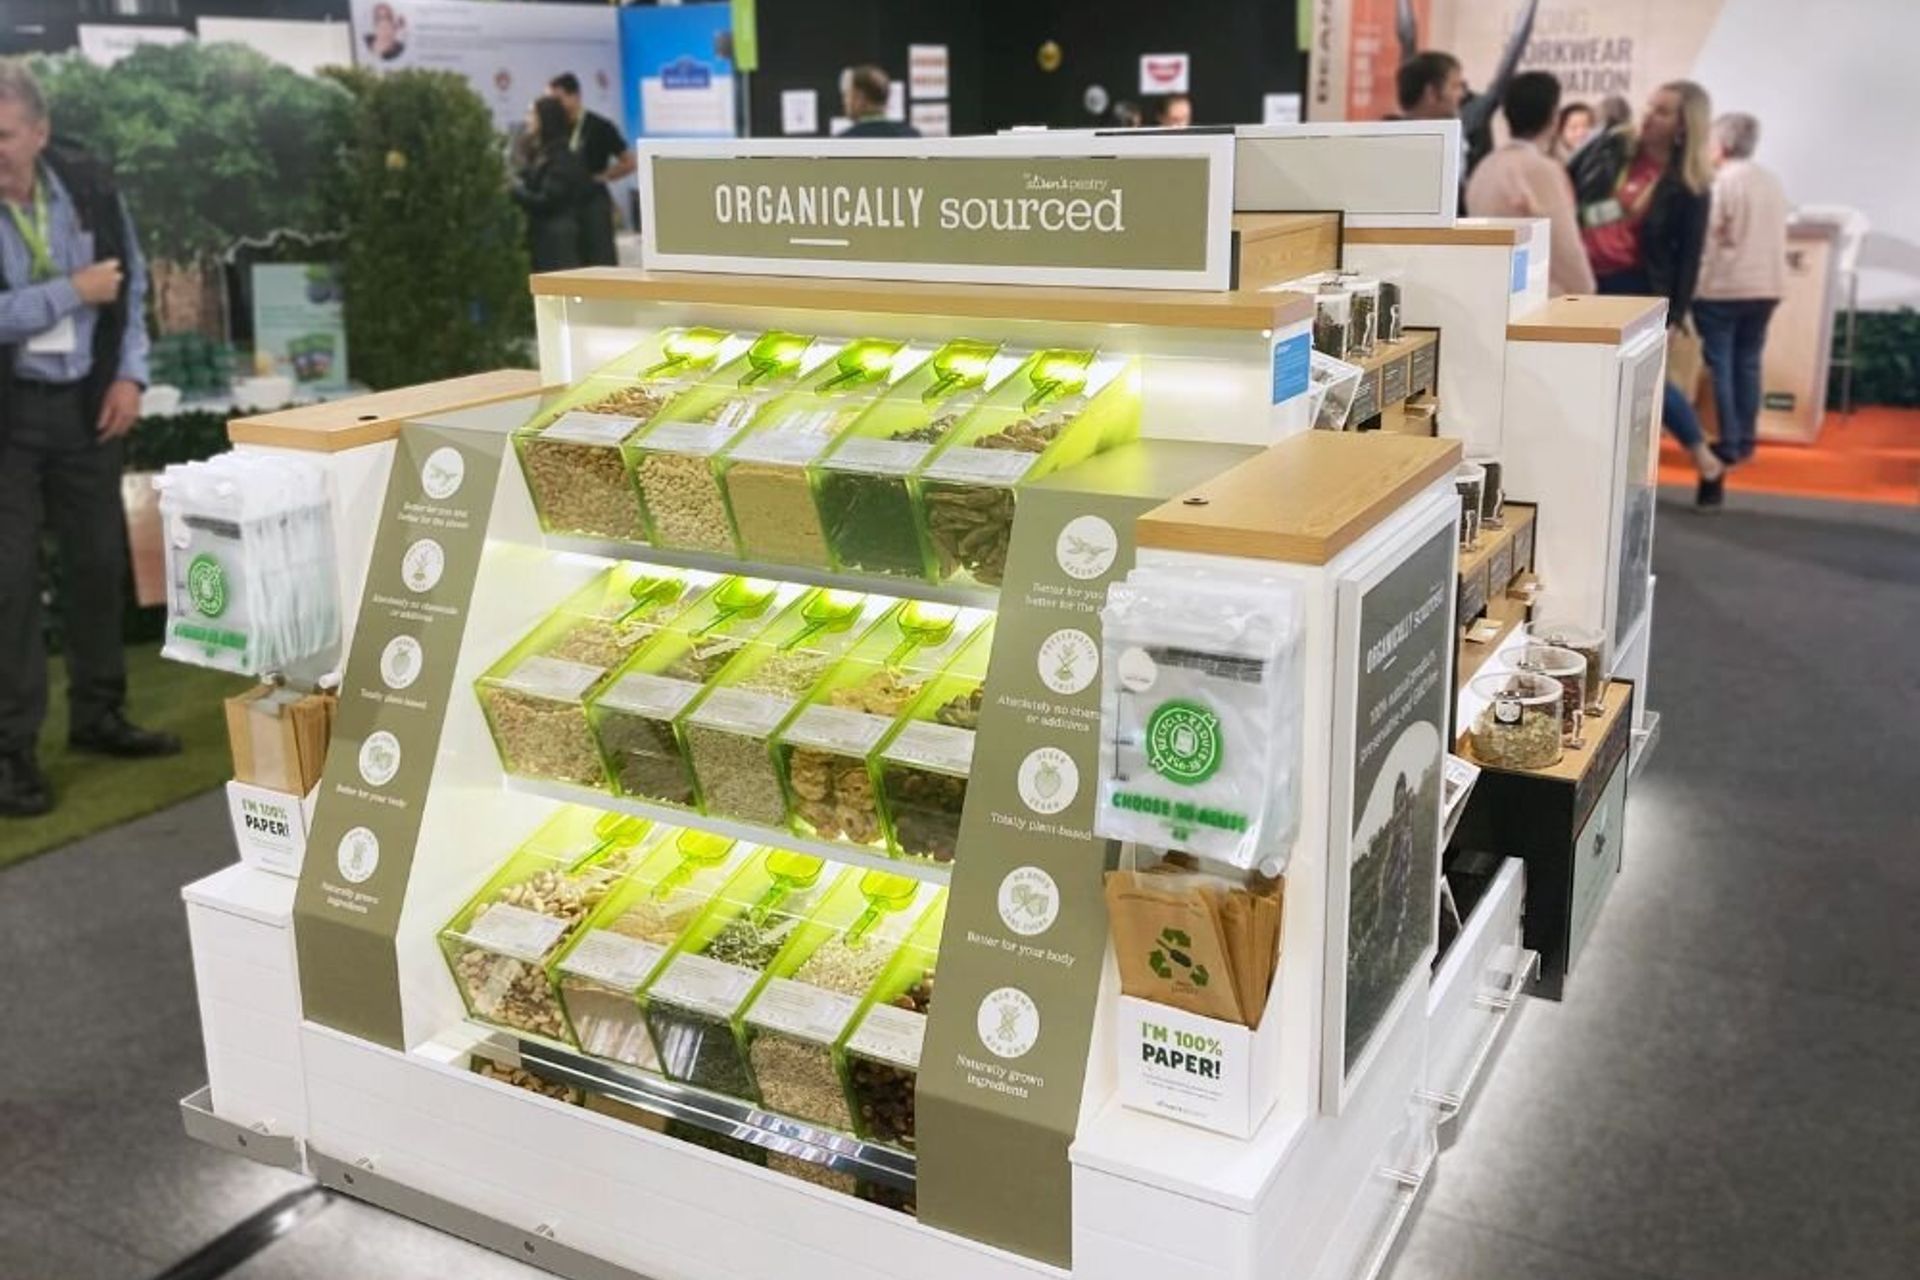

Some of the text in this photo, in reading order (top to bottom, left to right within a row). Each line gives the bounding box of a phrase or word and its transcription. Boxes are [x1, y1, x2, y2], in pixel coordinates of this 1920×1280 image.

[1519, 37, 1633, 64] ORKWEAR
[715, 184, 1125, 232] ORGANICALLY sourced
[1066, 585, 1081, 598] for
[1059, 599, 1076, 611] for
[1077, 601, 1095, 613] the
[996, 694, 1051, 715] Absolutely
[1053, 704, 1069, 716] no
[1040, 716, 1090, 732] additives
[244, 813, 290, 838] PAPER!
[990, 811, 1092, 842] Totally plant-based
[967, 930, 1075, 967] Better for your body
[1142, 1021, 1223, 1057] I'M 100%
[956, 1053, 1044, 1088] Naturally grown
[1142, 1042, 1221, 1081] PAPER!
[967, 1072, 1029, 1099] ingredients
